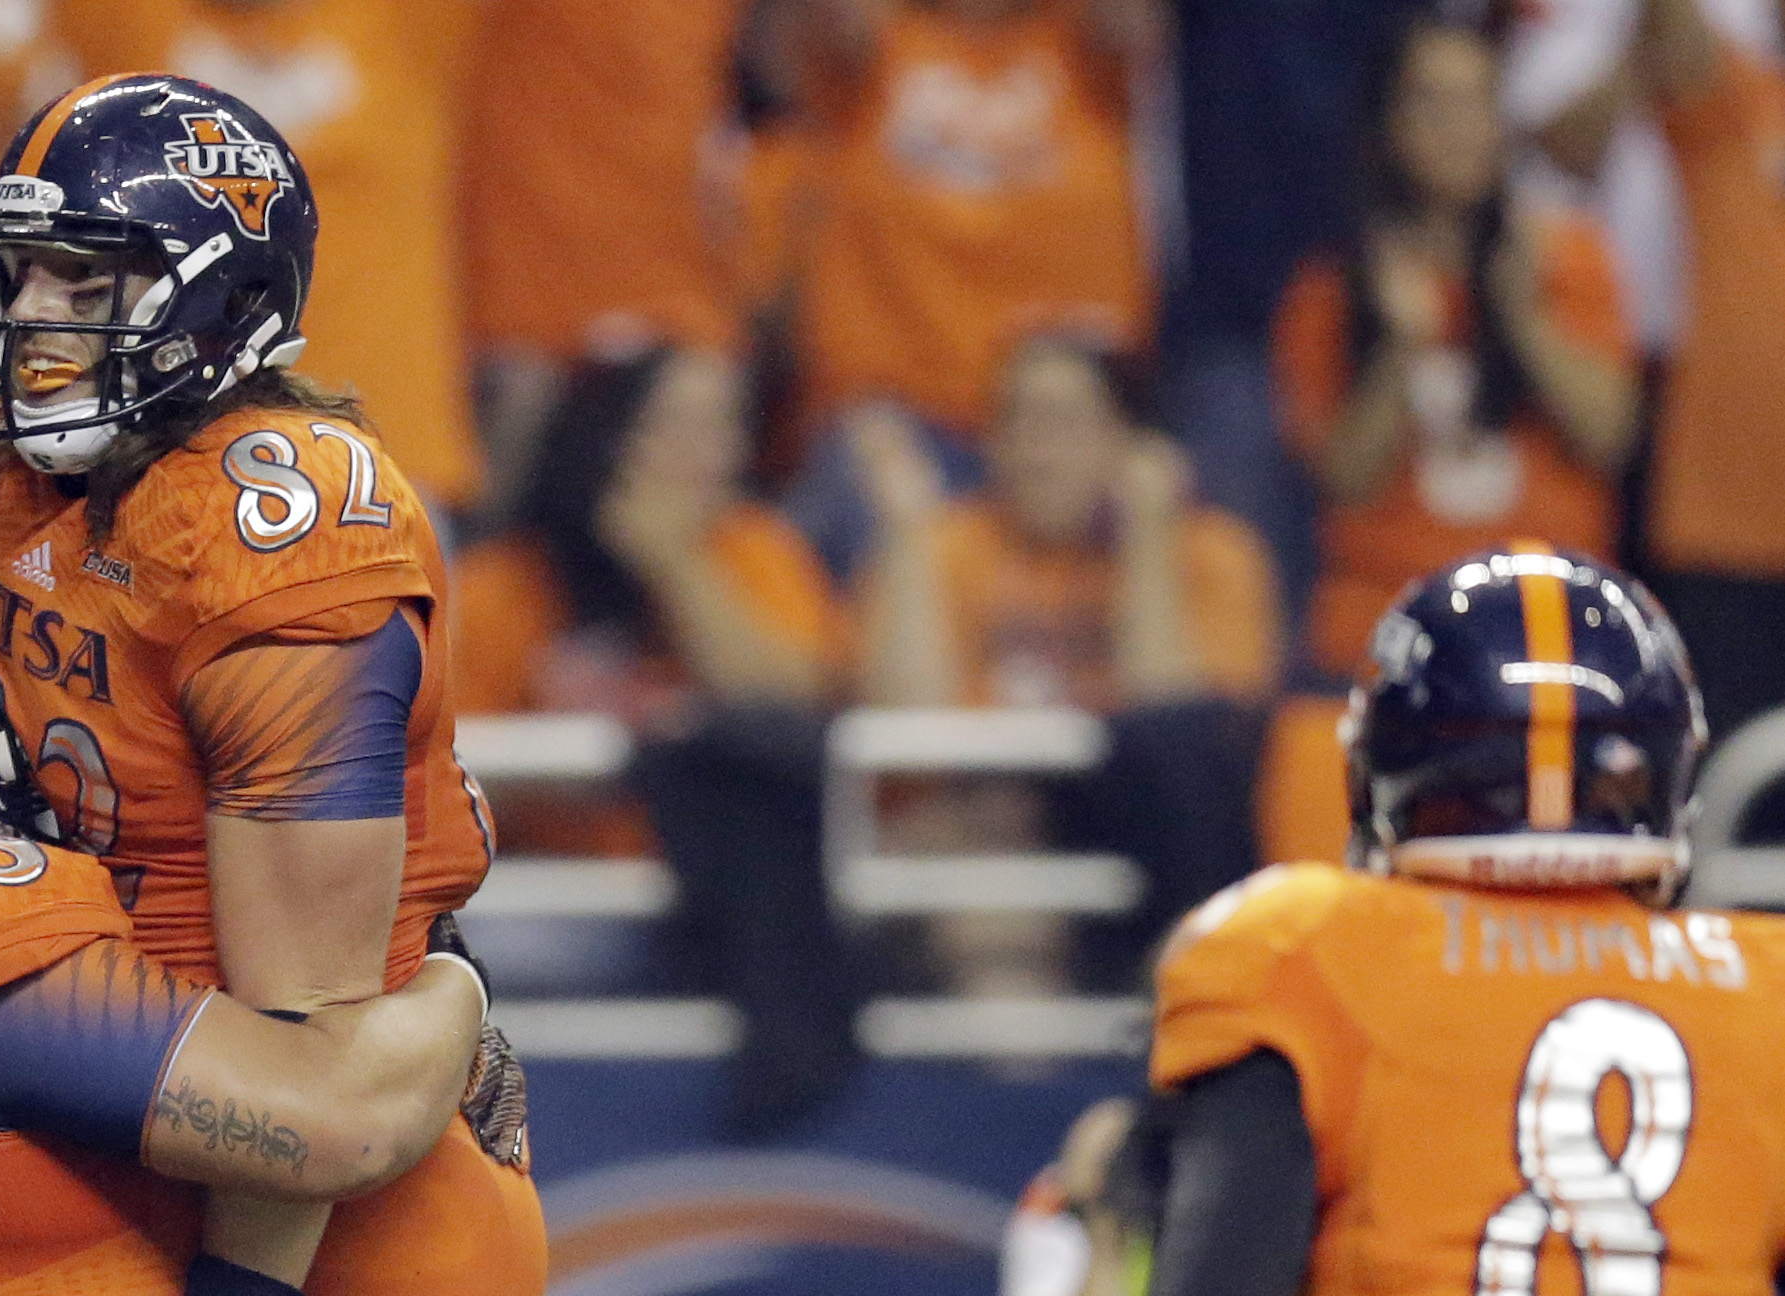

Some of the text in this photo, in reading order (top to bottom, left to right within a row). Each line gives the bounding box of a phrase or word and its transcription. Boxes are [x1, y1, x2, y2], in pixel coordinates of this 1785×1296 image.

[185, 144, 296, 180] UTSA
[222, 422, 393, 555] 82
[1440, 894, 1749, 992] THOMAS
